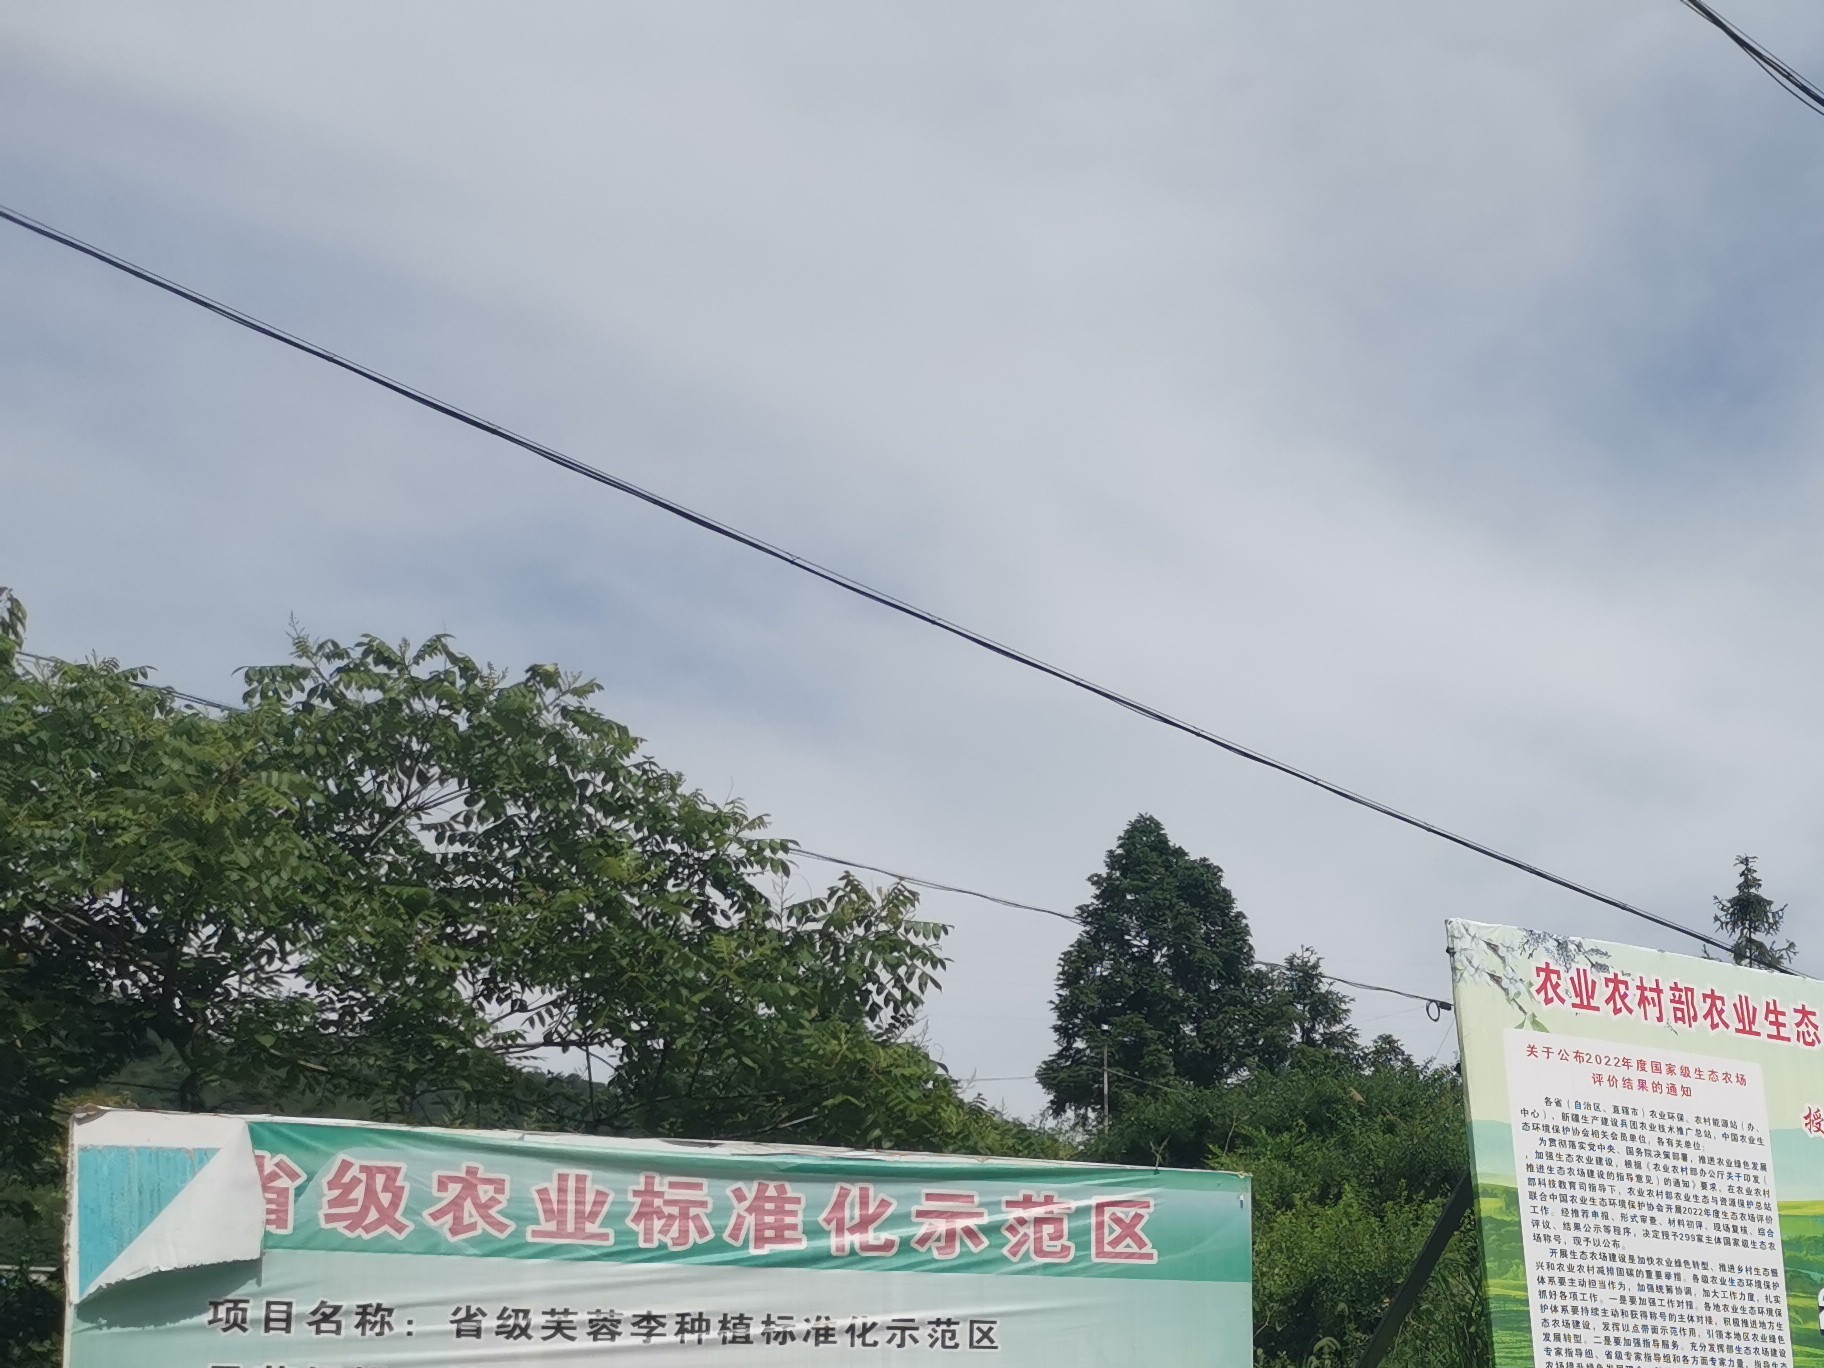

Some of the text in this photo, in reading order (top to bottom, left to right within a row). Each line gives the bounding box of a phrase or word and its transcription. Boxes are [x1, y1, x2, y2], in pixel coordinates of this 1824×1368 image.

[1525, 1043, 1748, 1087] 关于公布2022年度国家级生态农场
[1591, 1072, 1693, 1098] 评价结果的通知
[256, 1152, 1157, 1263] 省级农业标准化示范区
